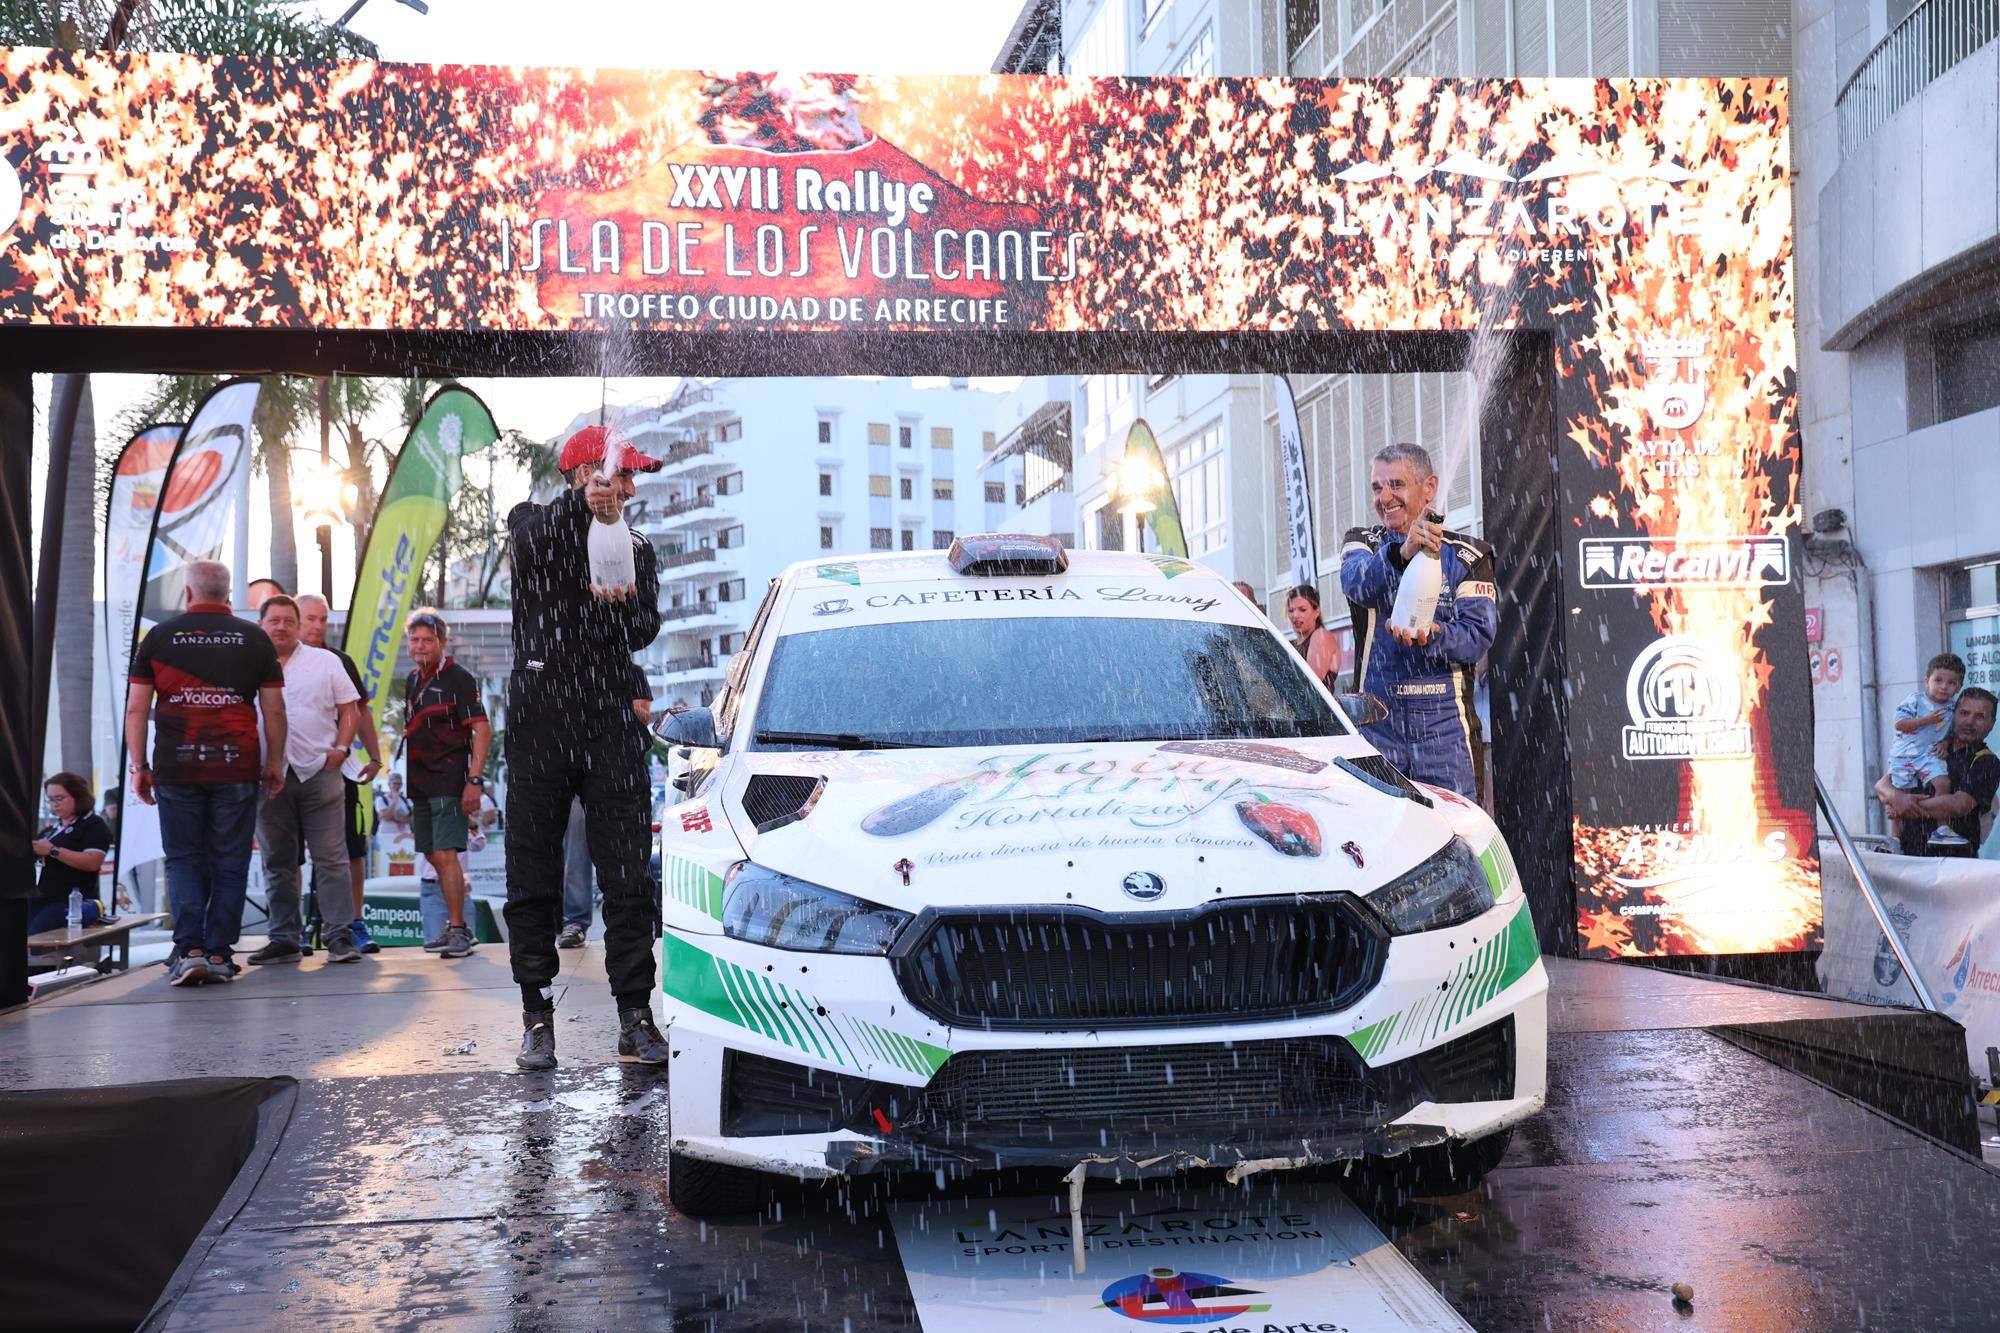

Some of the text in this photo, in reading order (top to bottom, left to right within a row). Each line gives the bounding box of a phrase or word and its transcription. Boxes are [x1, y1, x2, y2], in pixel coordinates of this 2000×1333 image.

[668, 164, 934, 227] XXVII Rallye
[501, 217, 1085, 282] ISLA DE LOS VOLCANES
[1509, 249, 1610, 263] DIFERENT
[581, 291, 1009, 324] TROFEO CIUDAD DE ARRECIFE
[866, 585, 1222, 612] CAFETERÍA Larry
[172, 636, 245, 646] LANZAROTE
[1657, 669, 1715, 716] FCA
[1629, 730, 1746, 756] AUTOMOV
[361, 903, 424, 925] Campeon
[957, 1214, 1311, 1244] LANZAROTE
[1104, 1230, 1324, 1250] DESTINATION
